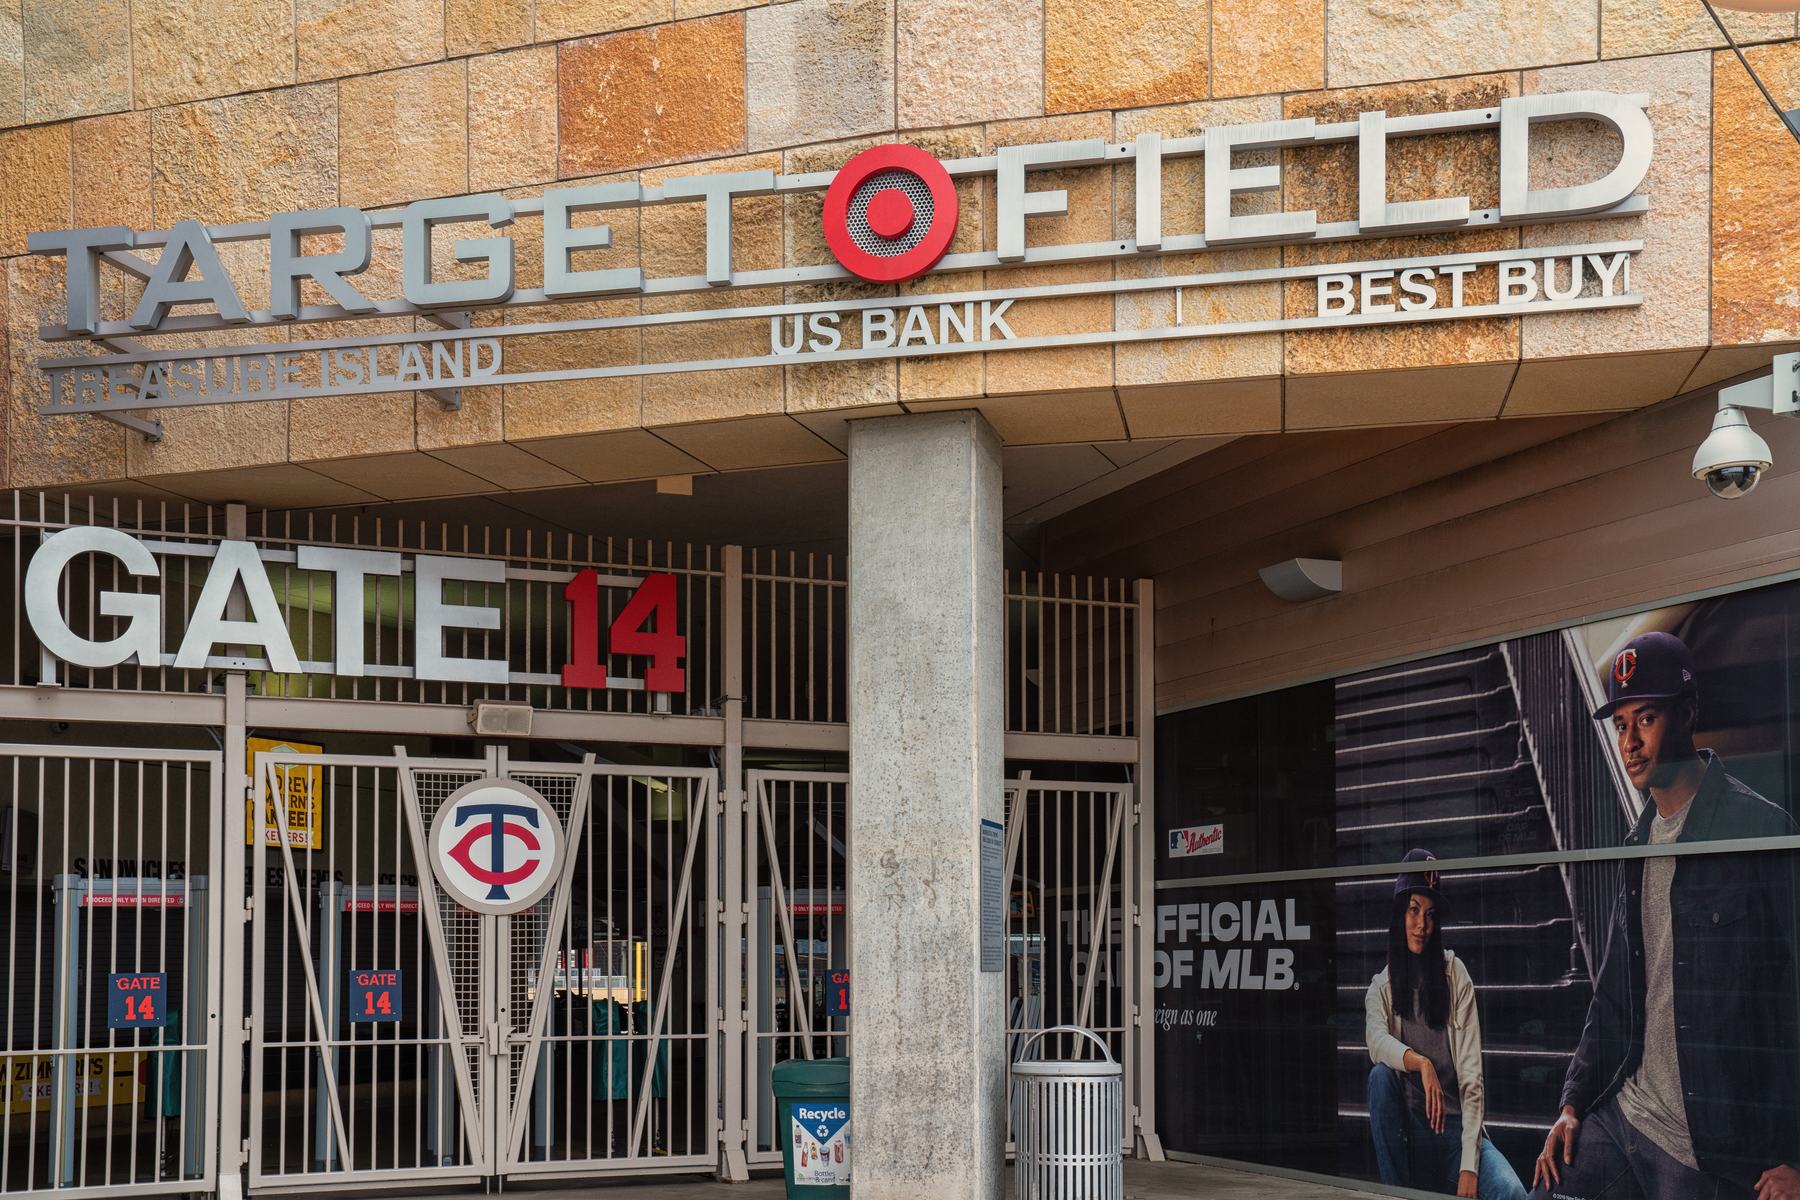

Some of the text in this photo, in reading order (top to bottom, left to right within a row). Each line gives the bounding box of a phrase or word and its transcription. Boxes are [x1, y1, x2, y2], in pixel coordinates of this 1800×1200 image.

[28, 91, 1654, 335] TARGET FIELD
[1316, 250, 1625, 319] BEST BUY
[769, 299, 1018, 357] US BANK
[50, 337, 502, 406] TREASURE ISLAND
[24, 526, 686, 692] GATE 14
[1155, 898, 1311, 944] FFICIAL
[117, 977, 161, 990] GATE
[357, 974, 397, 986] GATE
[832, 972, 850, 984] GA
[125, 996, 154, 1020] 14
[364, 991, 391, 1015] 14
[838, 988, 850, 1010] 1
[1154, 1002, 1218, 1031] eign as one
[799, 1107, 846, 1122] Recycle
